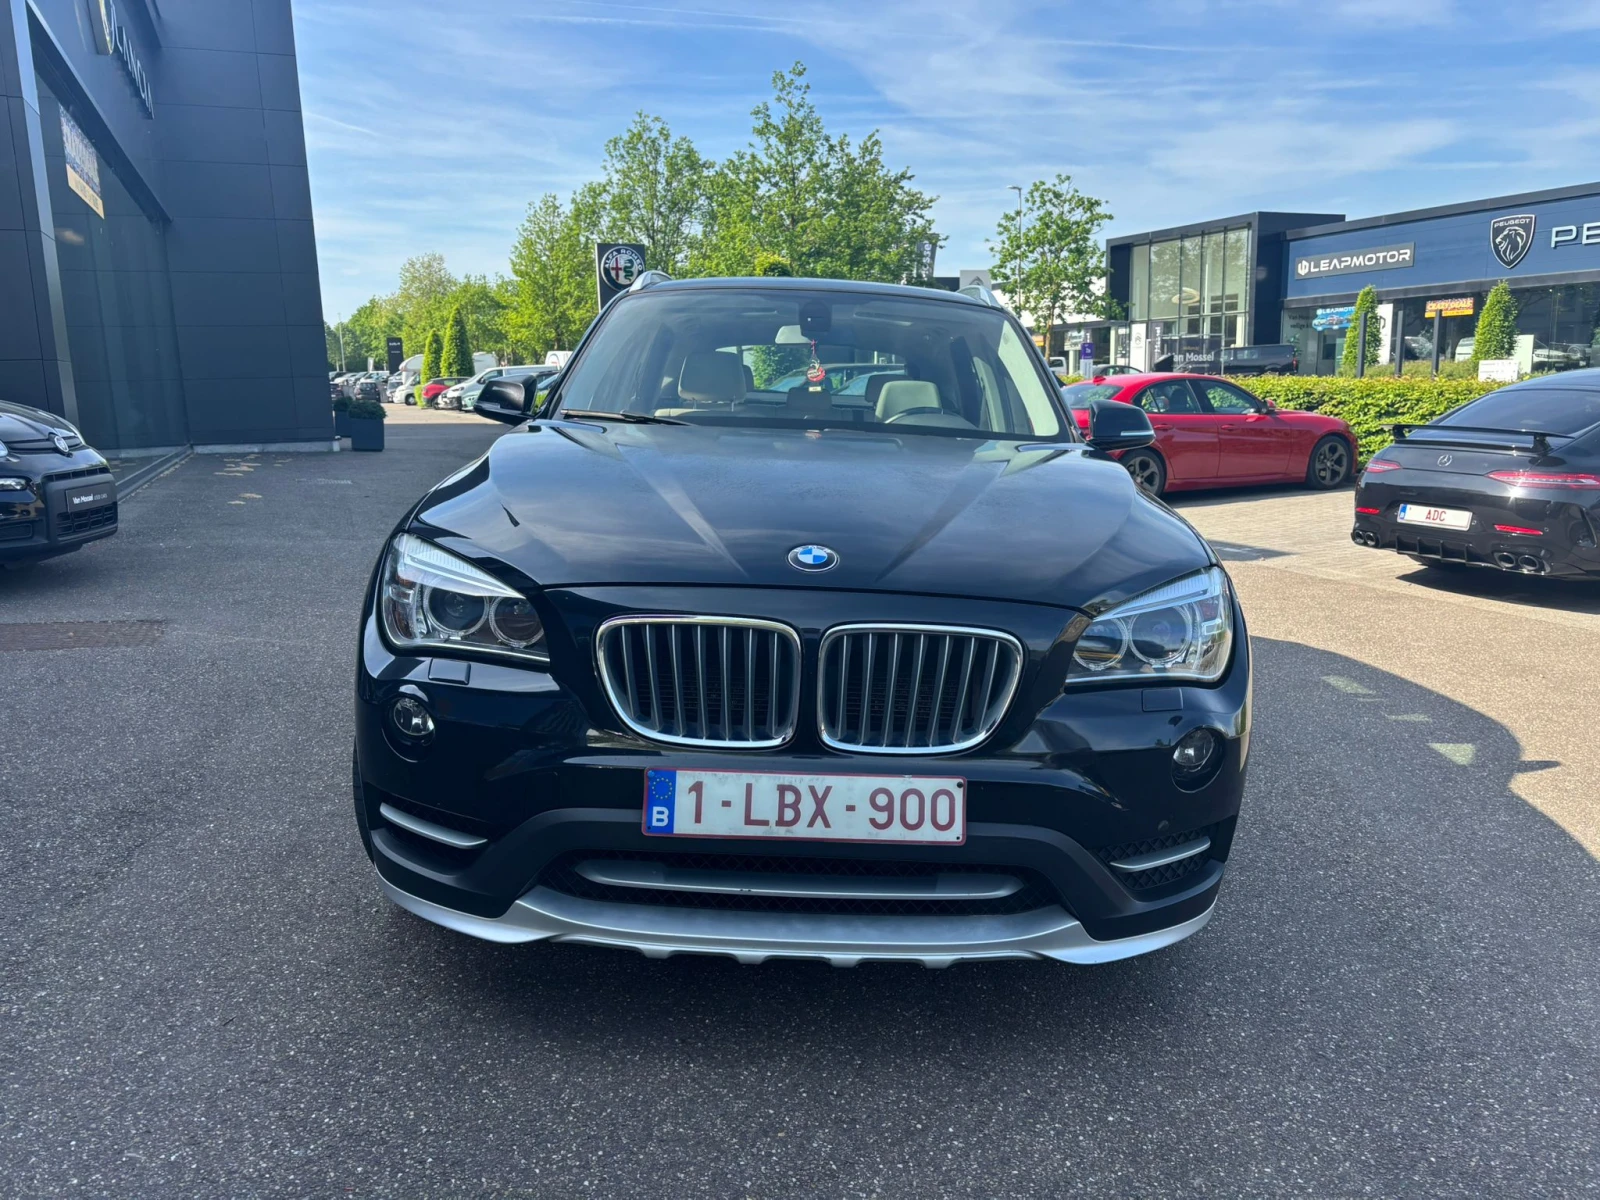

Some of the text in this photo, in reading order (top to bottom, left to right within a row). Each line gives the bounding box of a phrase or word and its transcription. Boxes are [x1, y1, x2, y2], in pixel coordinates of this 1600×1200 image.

[1494, 218, 1531, 228] PEUGEOT
[620, 249, 643, 271] ROMEO
[1310, 248, 1411, 273] LEAPMOTOR
[1185, 351, 1215, 362] Mossel
[1425, 509, 1447, 522] ADC
[651, 806, 669, 827] B
